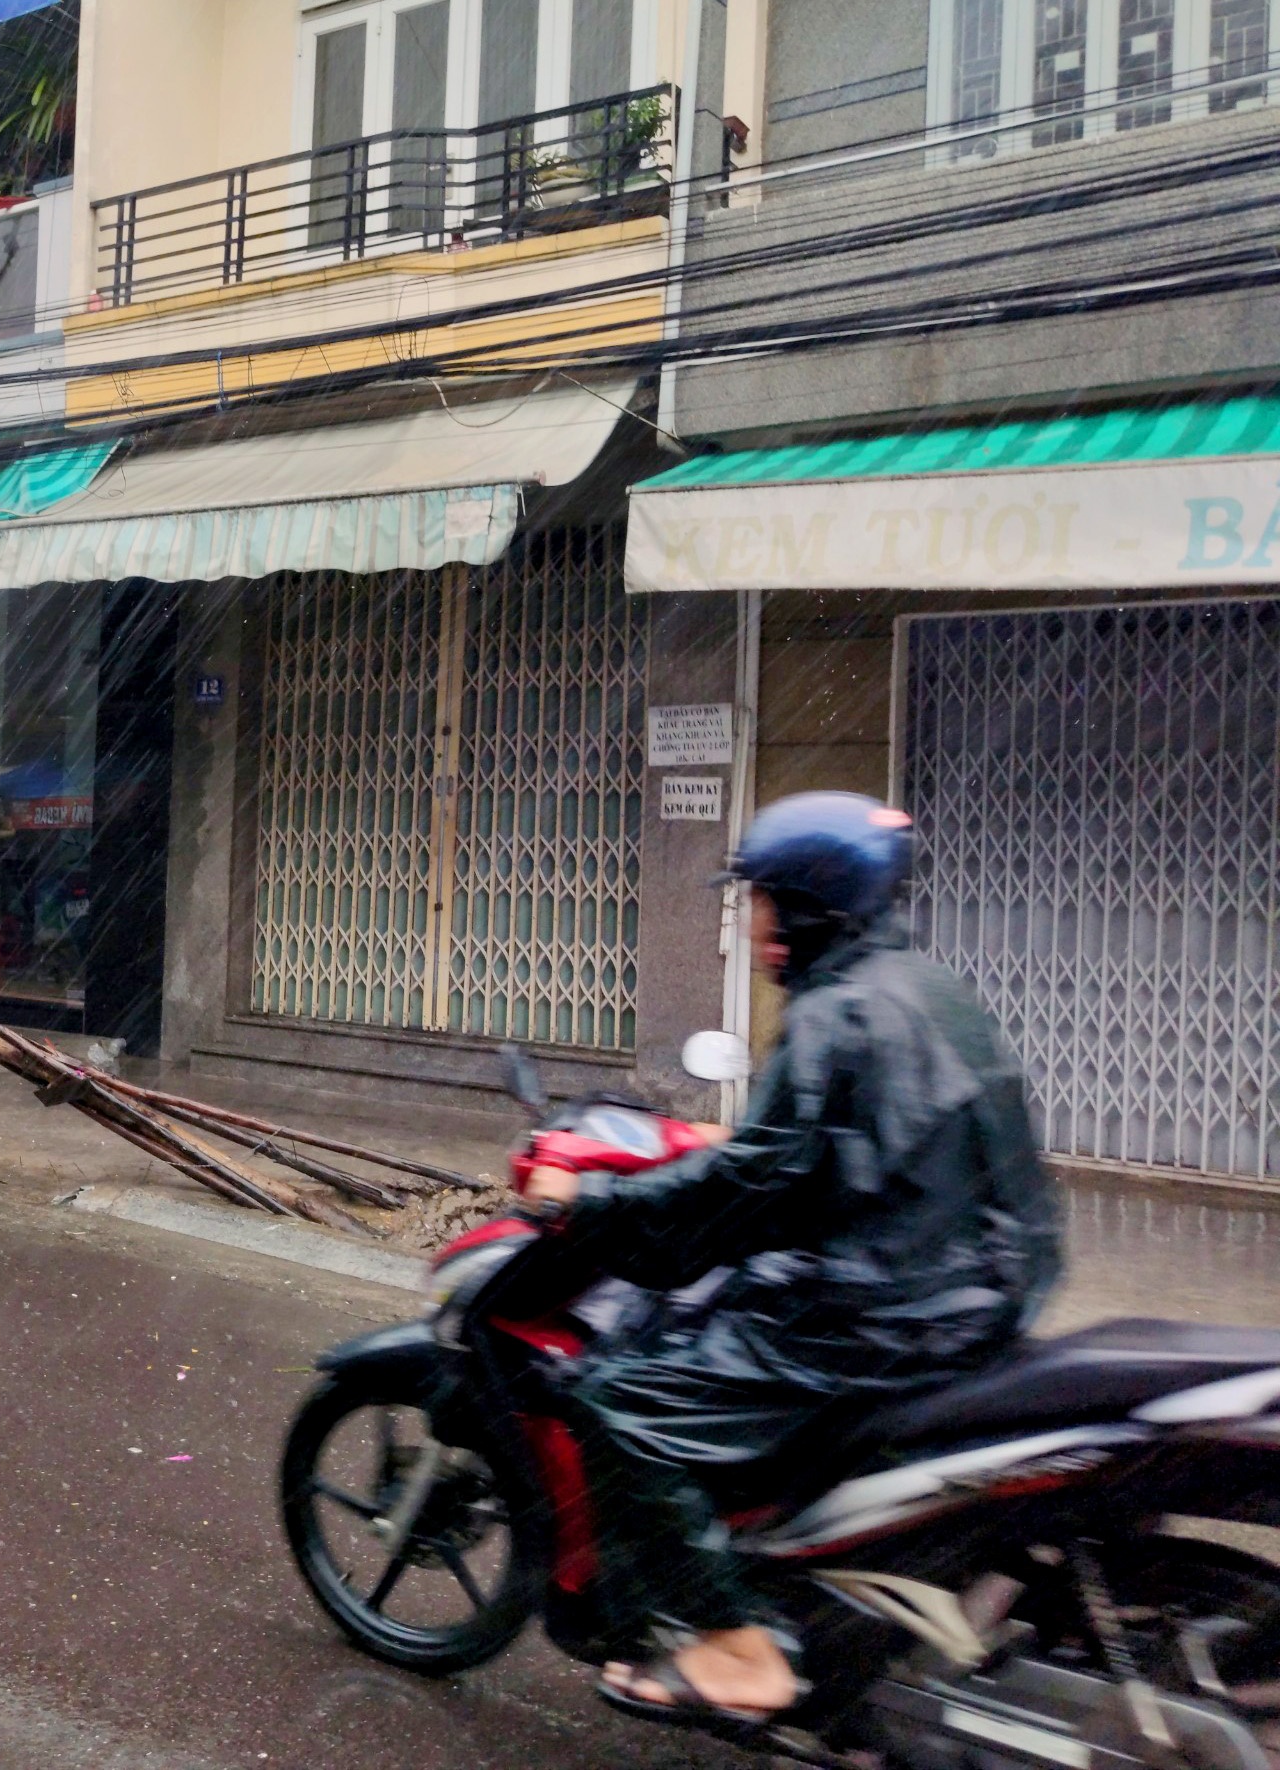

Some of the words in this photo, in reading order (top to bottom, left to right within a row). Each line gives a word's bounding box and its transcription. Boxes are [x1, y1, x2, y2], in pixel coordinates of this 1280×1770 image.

[661, 512, 837, 579] KEM
[200, 680, 219, 695] 12
[684, 783, 704, 795] KEM
[664, 803, 683, 815] KEM
